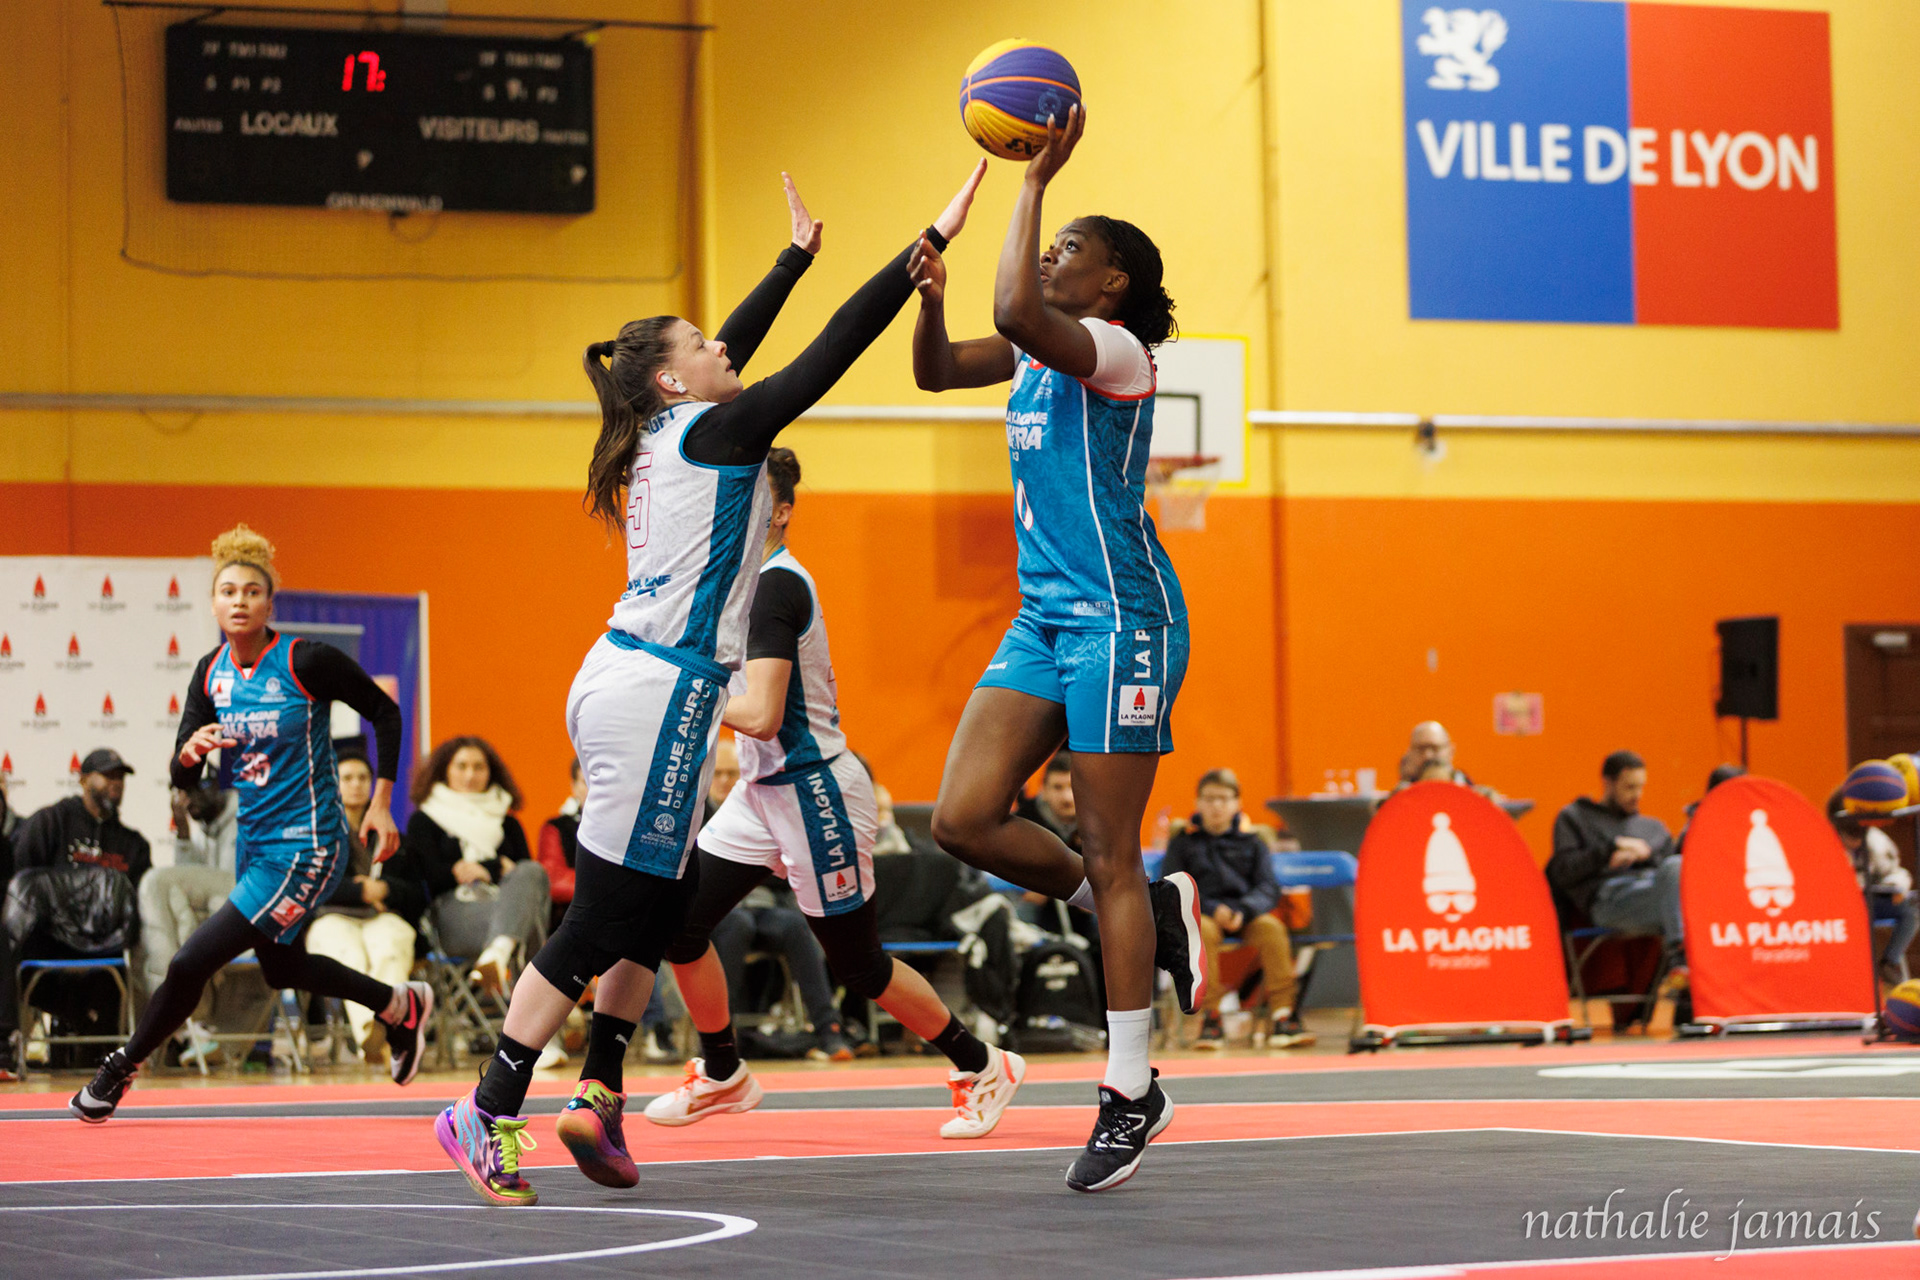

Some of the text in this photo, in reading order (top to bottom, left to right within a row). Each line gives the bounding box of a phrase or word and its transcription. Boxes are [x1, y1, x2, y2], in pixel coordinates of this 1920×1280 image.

[240, 111, 339, 137] LOCAUX
[418, 115, 540, 144] VISITEURS
[1416, 119, 1818, 192] VILLE DE LYON
[1134, 649, 1151, 678] LA
[658, 679, 704, 808] LIGUE AURA
[673, 790, 684, 809] DE
[828, 844, 846, 867] LA
[1382, 925, 1532, 953] LA PLAGNE
[1710, 918, 1848, 947] LA PLAGNE
